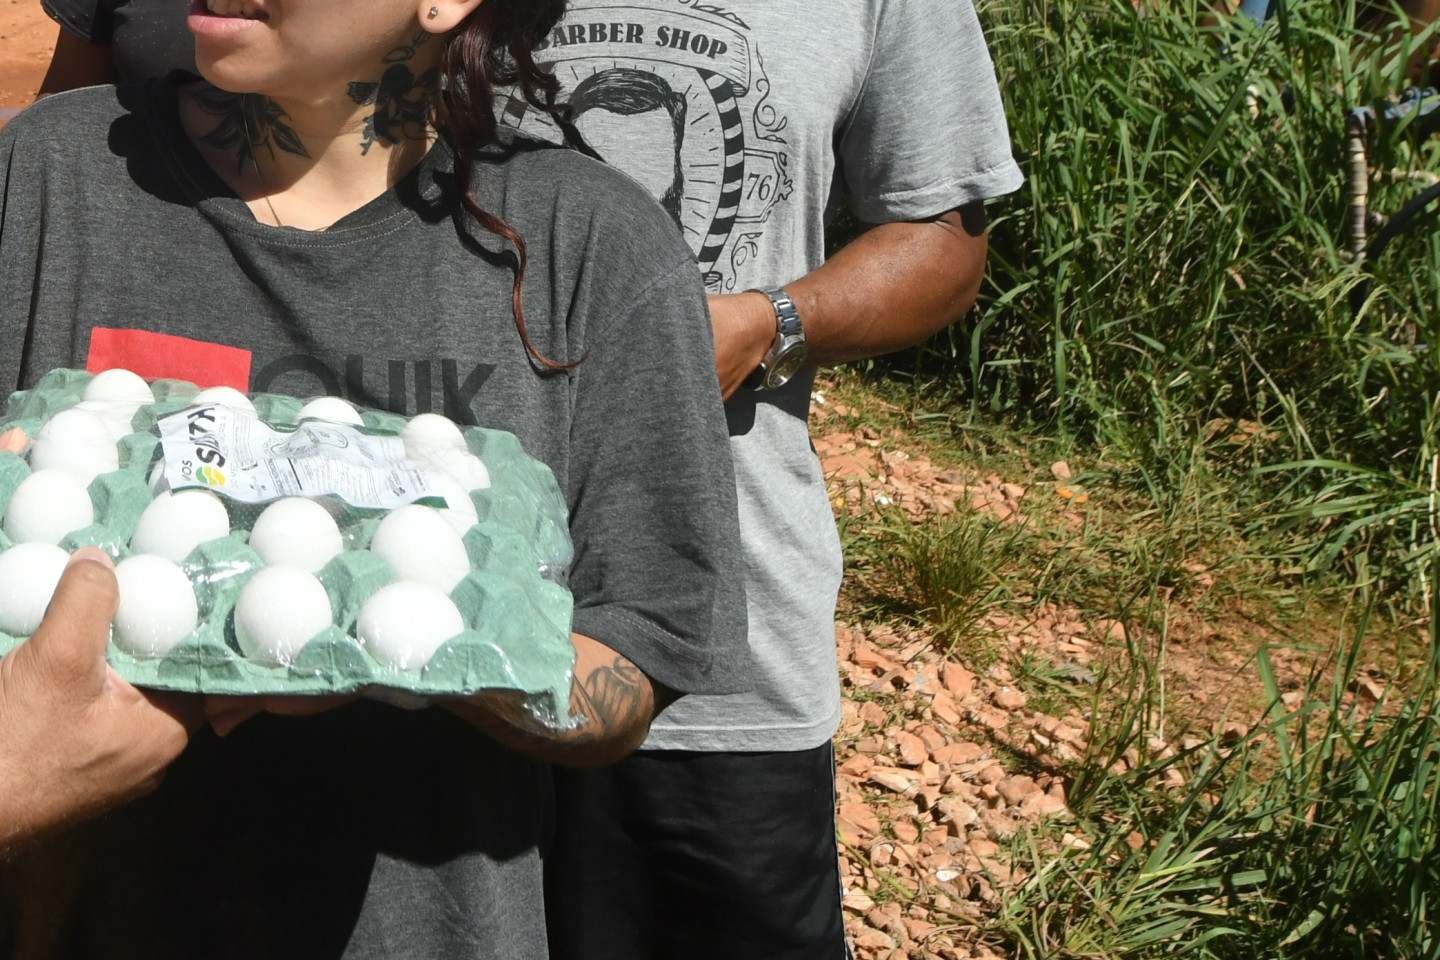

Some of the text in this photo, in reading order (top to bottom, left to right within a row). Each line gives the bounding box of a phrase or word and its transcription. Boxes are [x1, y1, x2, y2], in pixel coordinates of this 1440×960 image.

[540, 22, 728, 59] ARBER SHOP
[746, 172, 772, 200] 76
